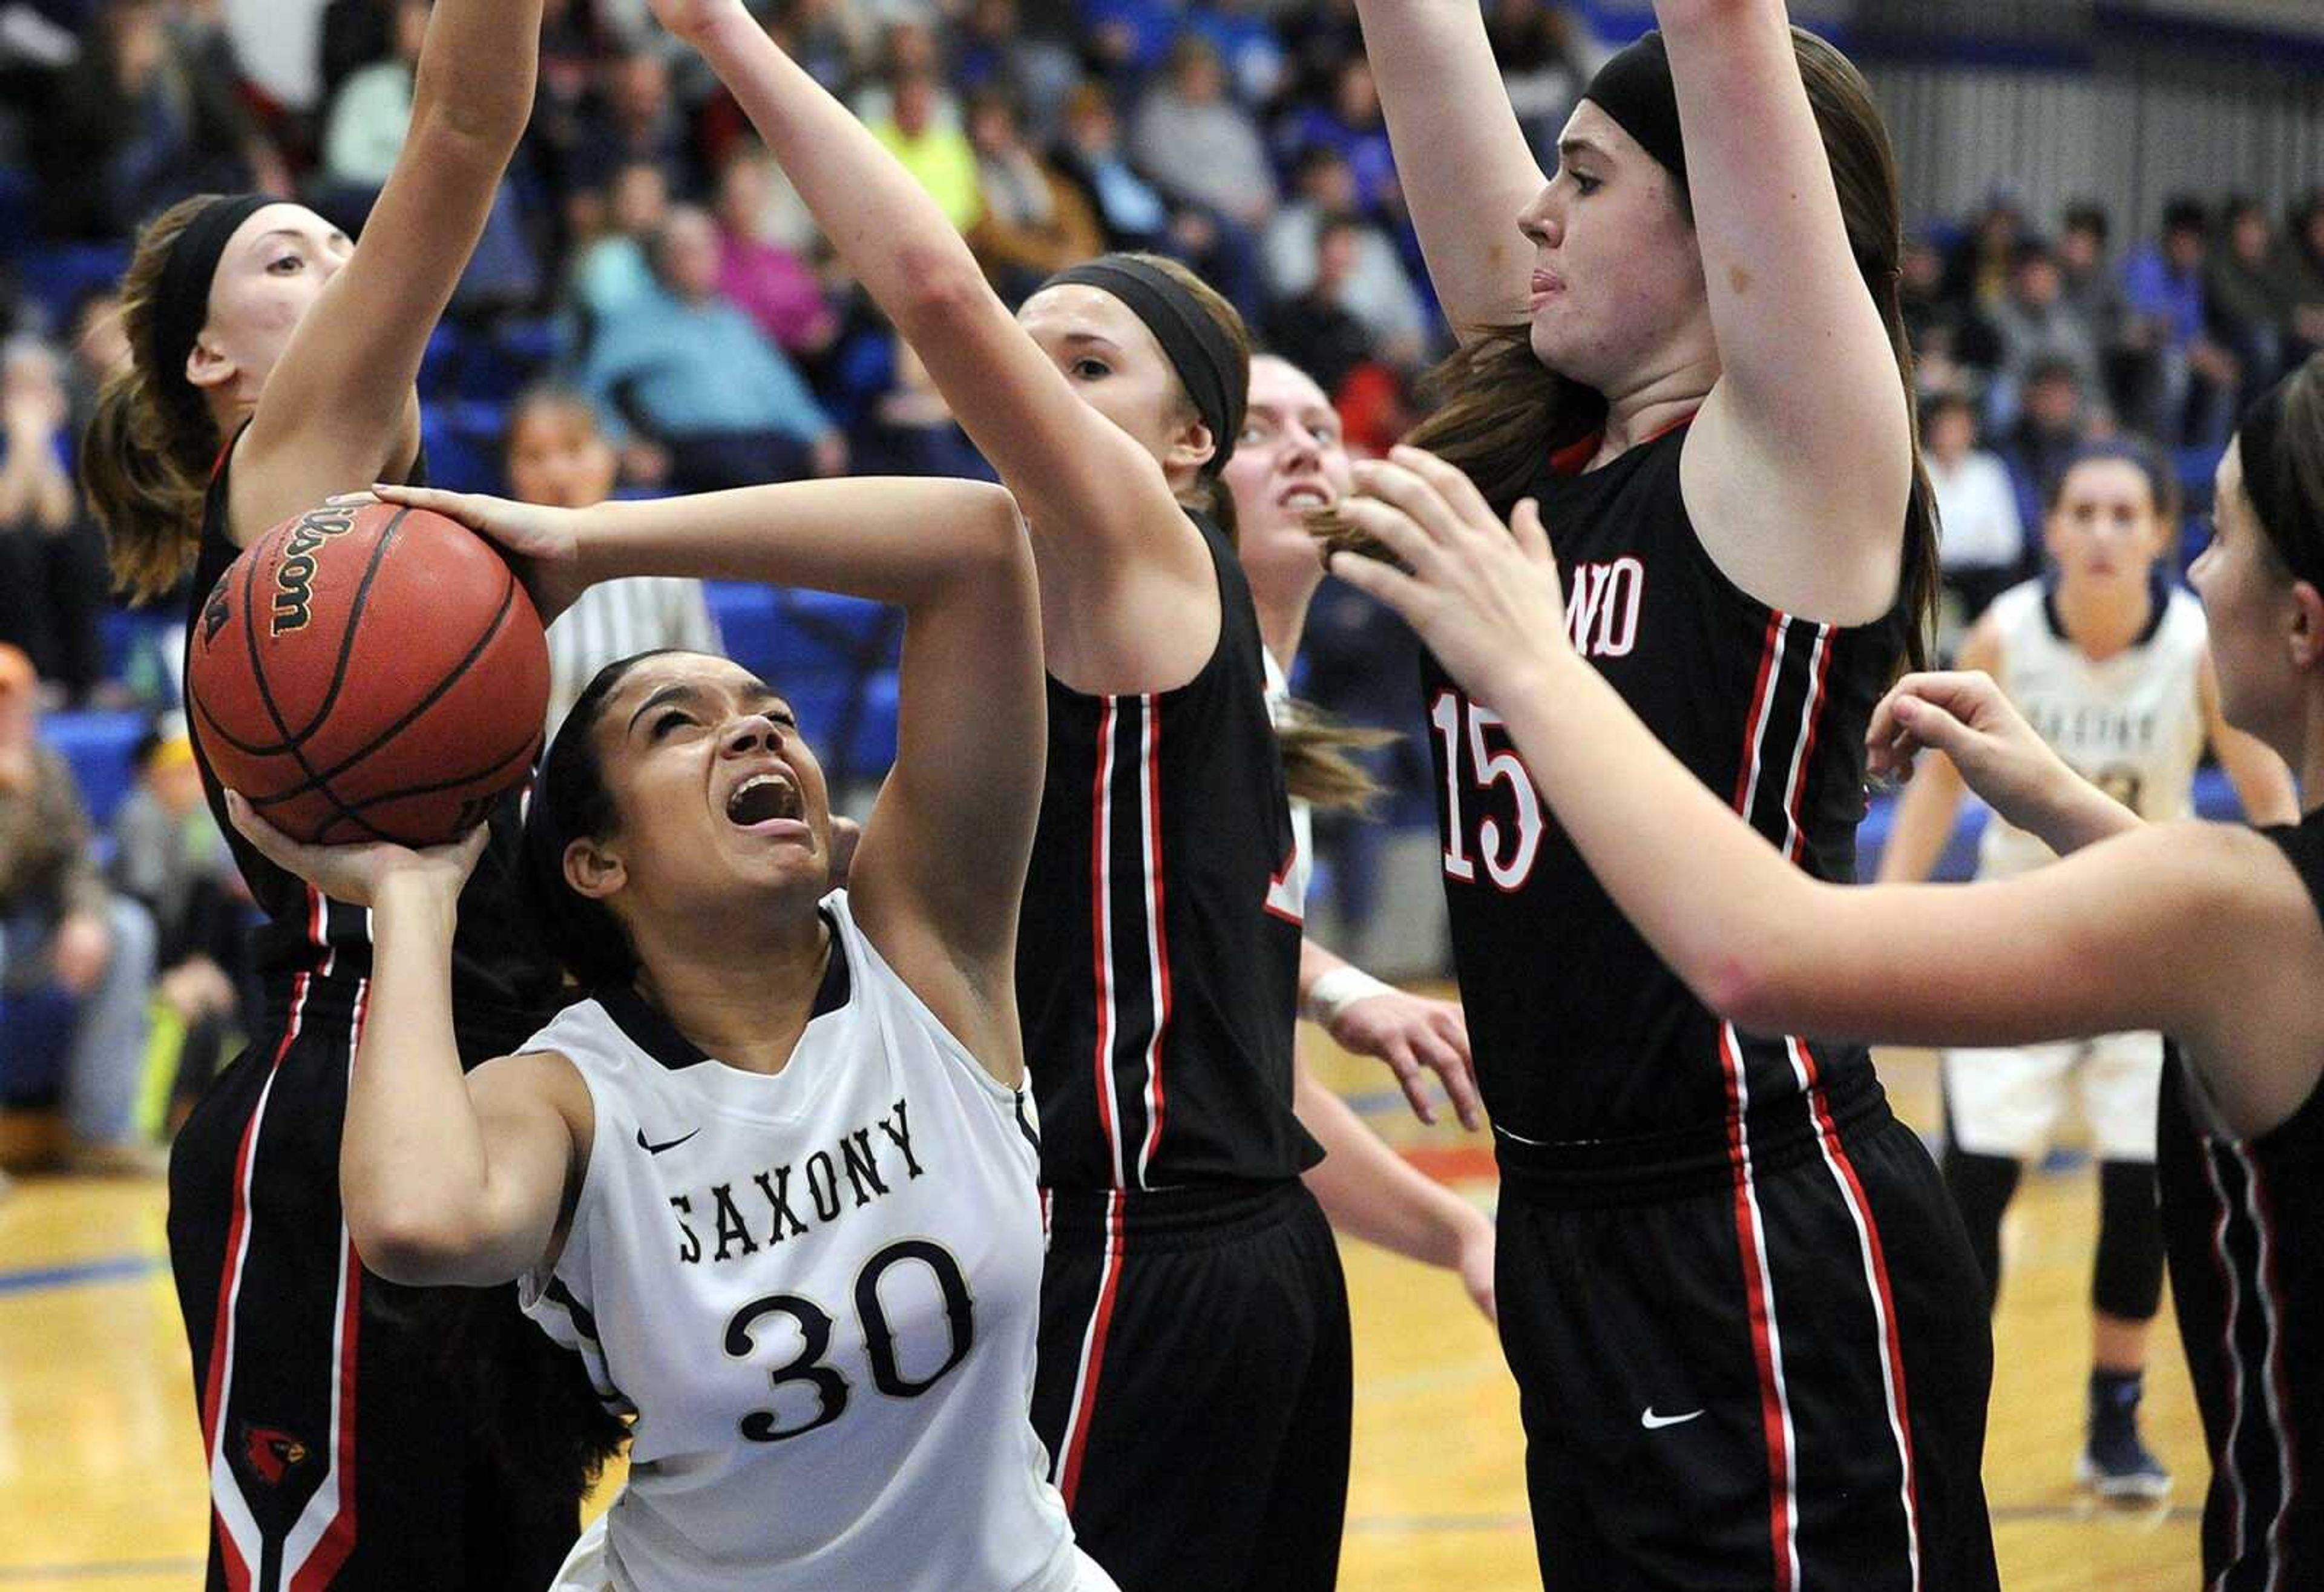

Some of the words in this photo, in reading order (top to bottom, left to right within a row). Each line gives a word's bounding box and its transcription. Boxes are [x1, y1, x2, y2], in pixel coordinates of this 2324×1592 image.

[271, 505, 357, 637] ilson
[1431, 689, 1544, 892] 15
[669, 1099, 925, 1264] SAXONY
[724, 1238, 974, 1442] 30
